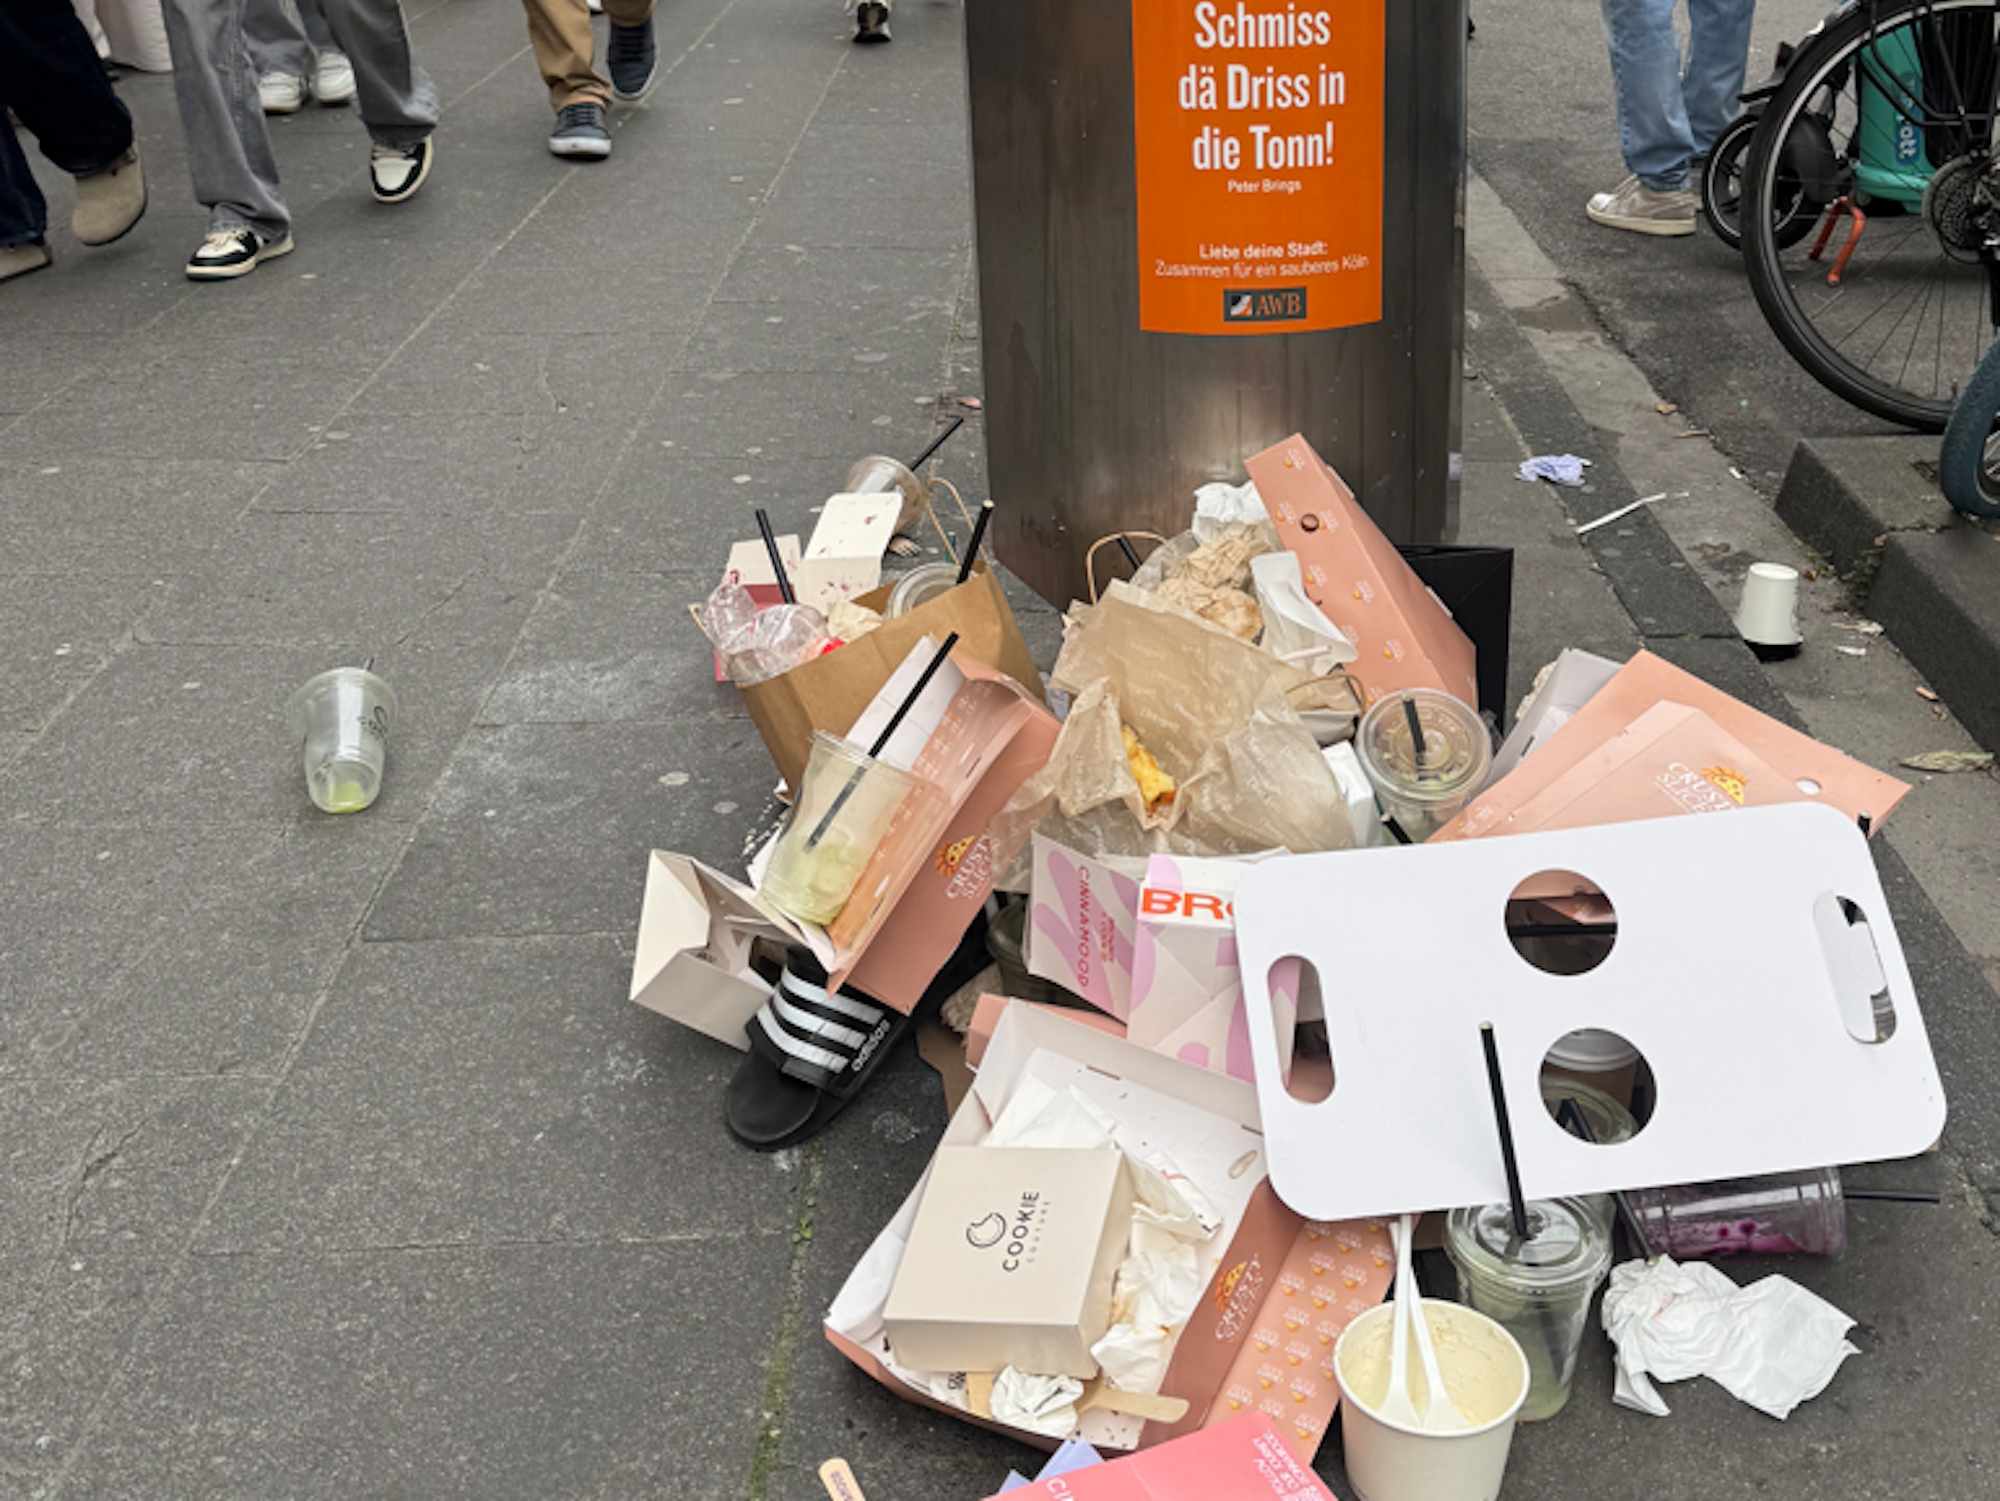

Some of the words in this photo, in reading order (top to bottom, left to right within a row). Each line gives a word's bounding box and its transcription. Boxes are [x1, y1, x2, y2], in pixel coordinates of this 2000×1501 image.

[1193, 1, 1332, 48] Schmiss
[1179, 64, 1217, 110] dä
[1227, 64, 1310, 110] Driss
[1318, 63, 1345, 106] in
[1193, 126, 1240, 170] die
[1249, 121, 1334, 170] Tonn!
[1227, 179, 1259, 193] Peter
[1262, 178, 1302, 195] Brings
[1155, 259, 1230, 277] Zusammen
[1233, 261, 1253, 278] für
[1255, 262, 1277, 278] ein
[1280, 259, 1339, 277] sauberes
[1342, 253, 1369, 271] Köln
[1199, 243, 1240, 259] Liebe
[1243, 243, 1284, 258] deine
[1255, 292, 1301, 316] AWB
[1668, 762, 1737, 810] CRUST
[1141, 887, 1235, 920] BR
[1078, 865, 1090, 987] CINNAMOOD
[1002, 1191, 1040, 1272] COOKIE
[1046, 1477, 1075, 1501] CI
